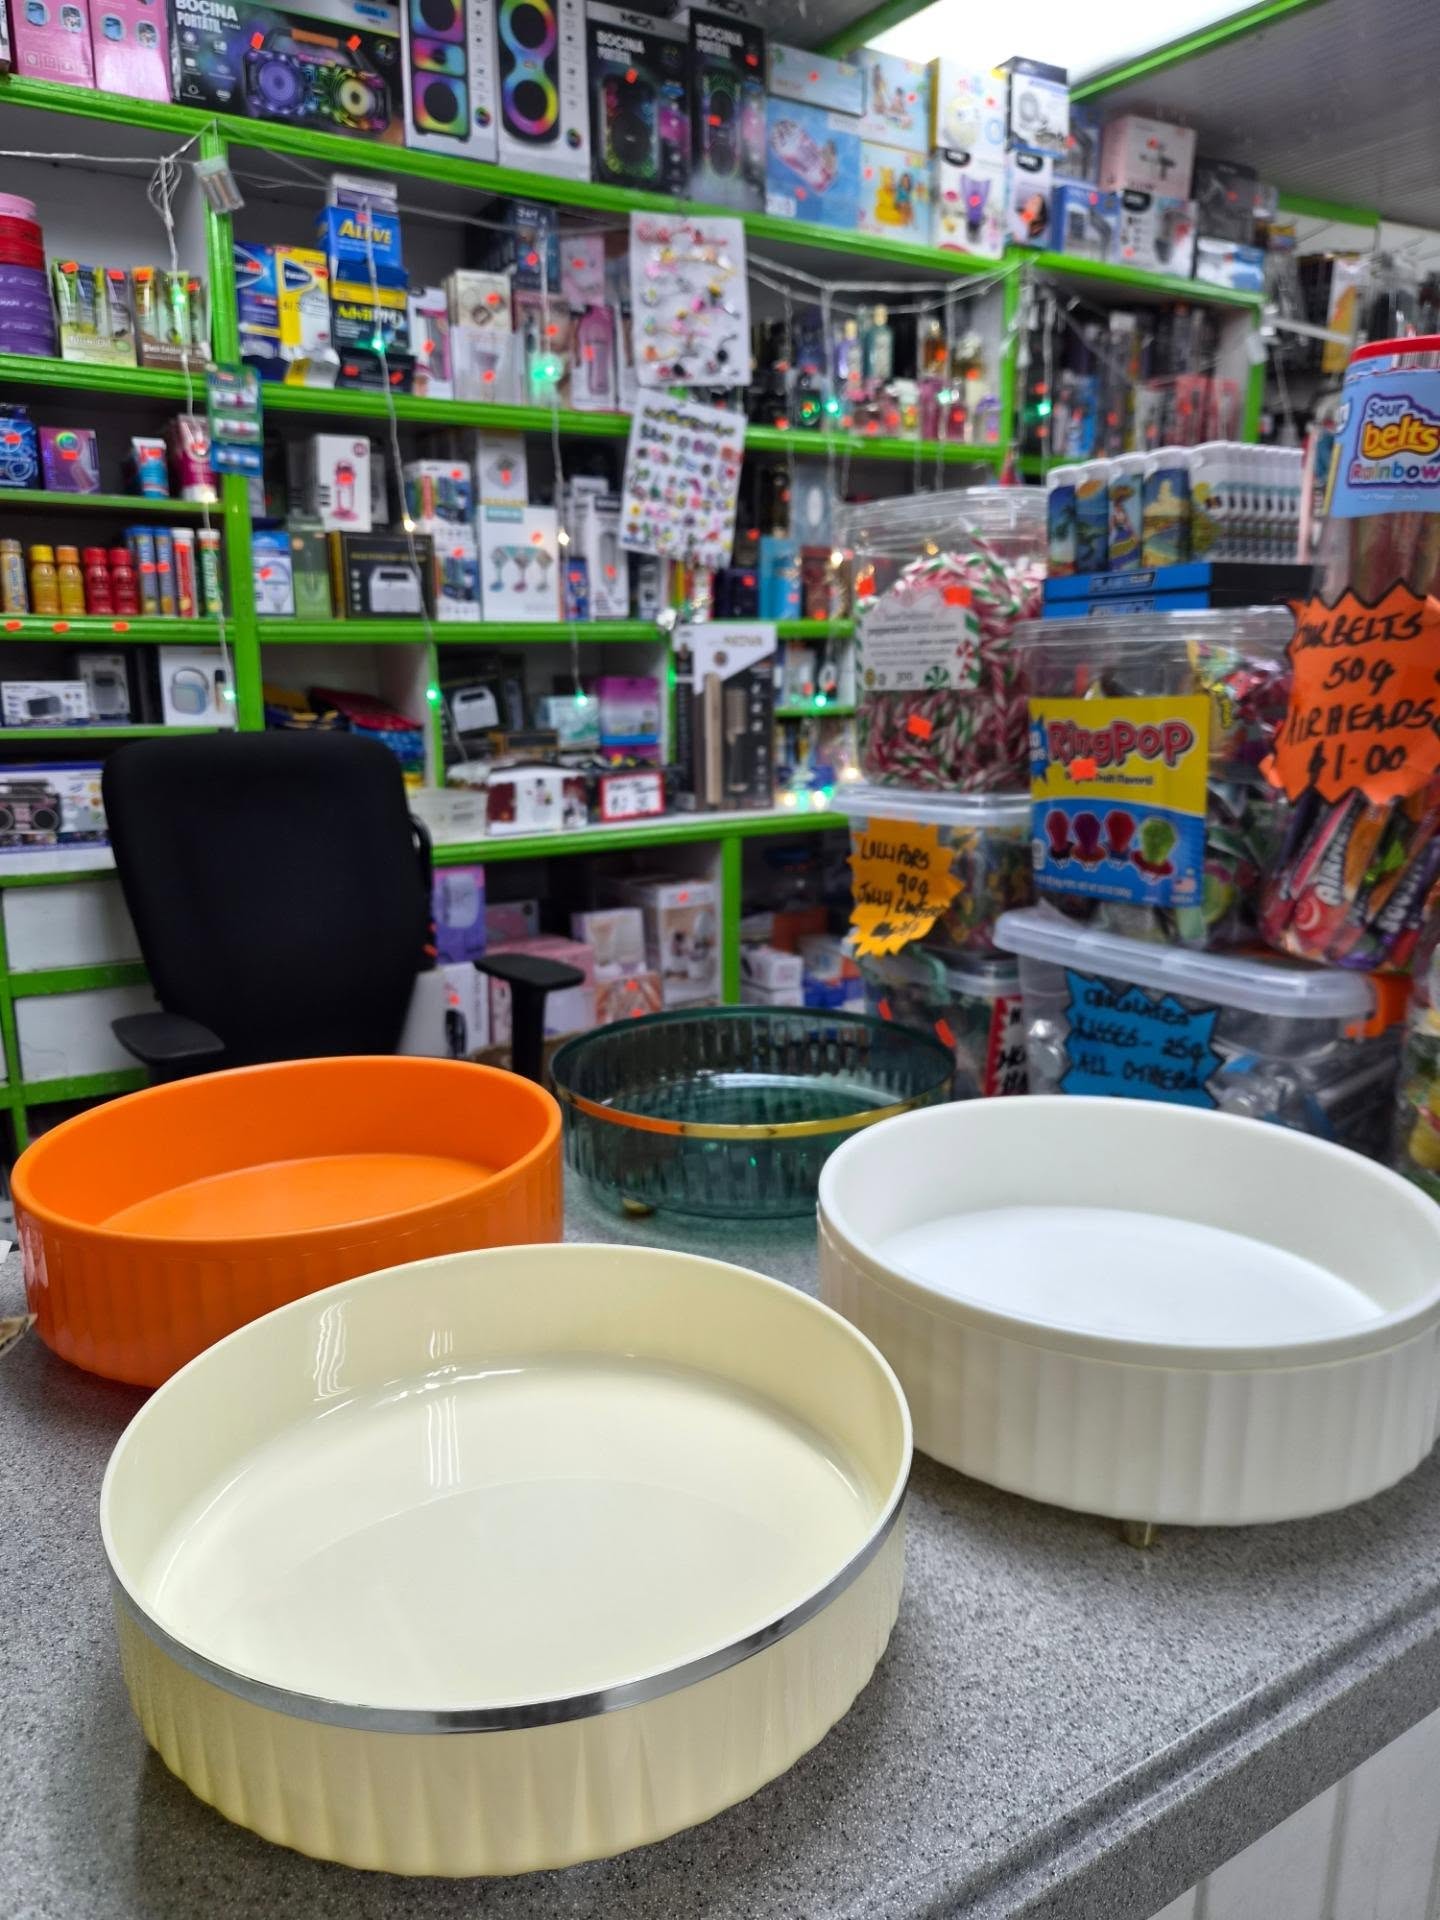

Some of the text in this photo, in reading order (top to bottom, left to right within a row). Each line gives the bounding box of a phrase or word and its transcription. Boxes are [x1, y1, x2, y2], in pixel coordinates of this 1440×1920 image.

[175, 0, 238, 21] BOCINA
[1368, 401, 1402, 418] Sour
[1361, 413, 1440, 460] belts
[1351, 461, 1440, 481] Rainbow
